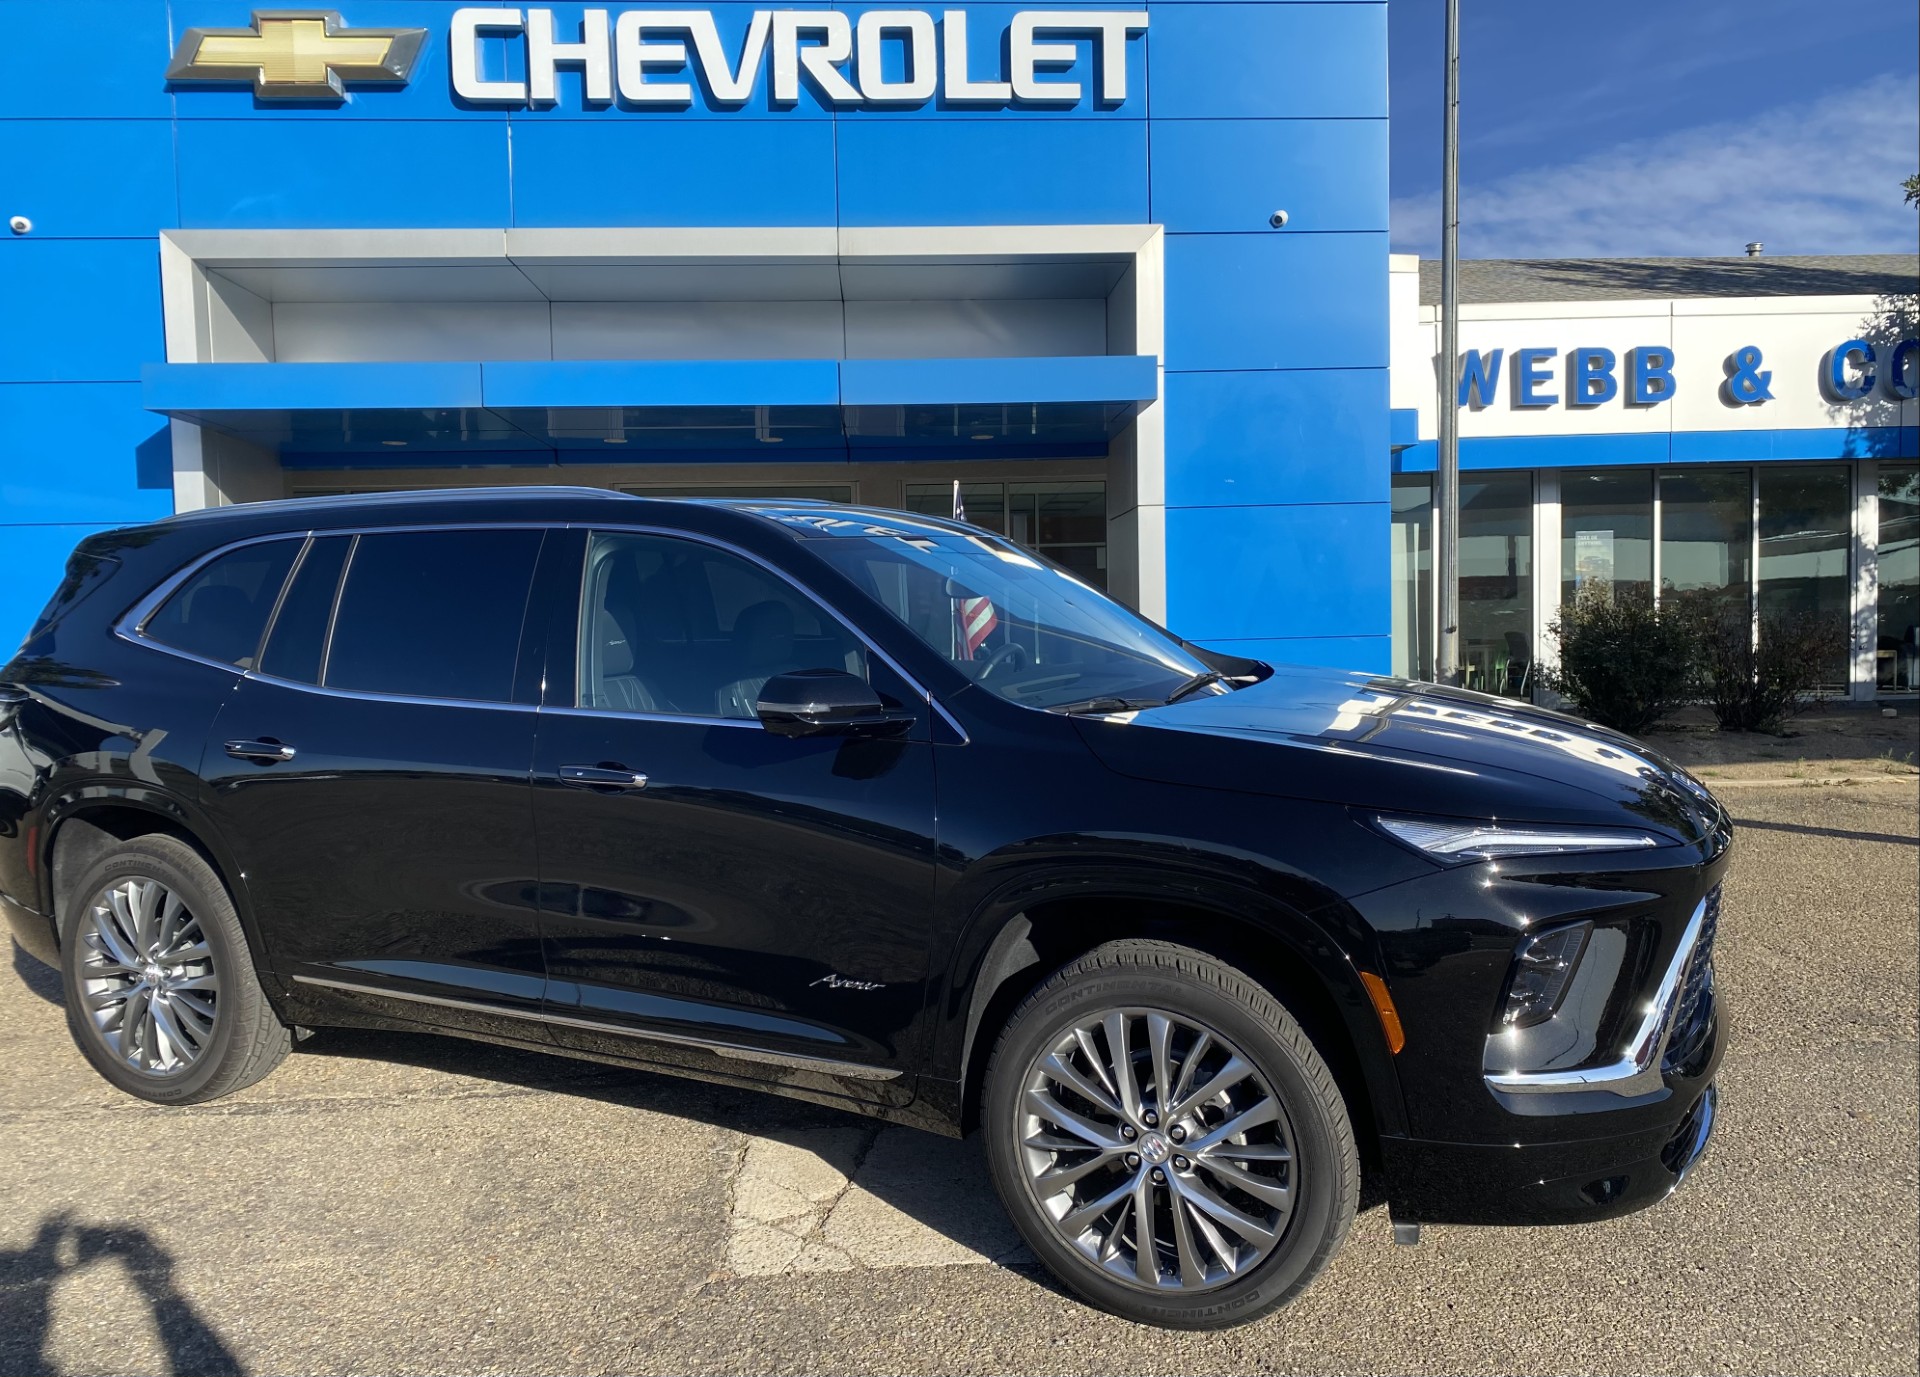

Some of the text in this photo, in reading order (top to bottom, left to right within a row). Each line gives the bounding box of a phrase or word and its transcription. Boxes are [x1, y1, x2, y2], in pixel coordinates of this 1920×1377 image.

[451, 8, 1149, 104] CHEVROLET
[1456, 346, 1677, 408] WEBB
[1731, 345, 1777, 404] &
